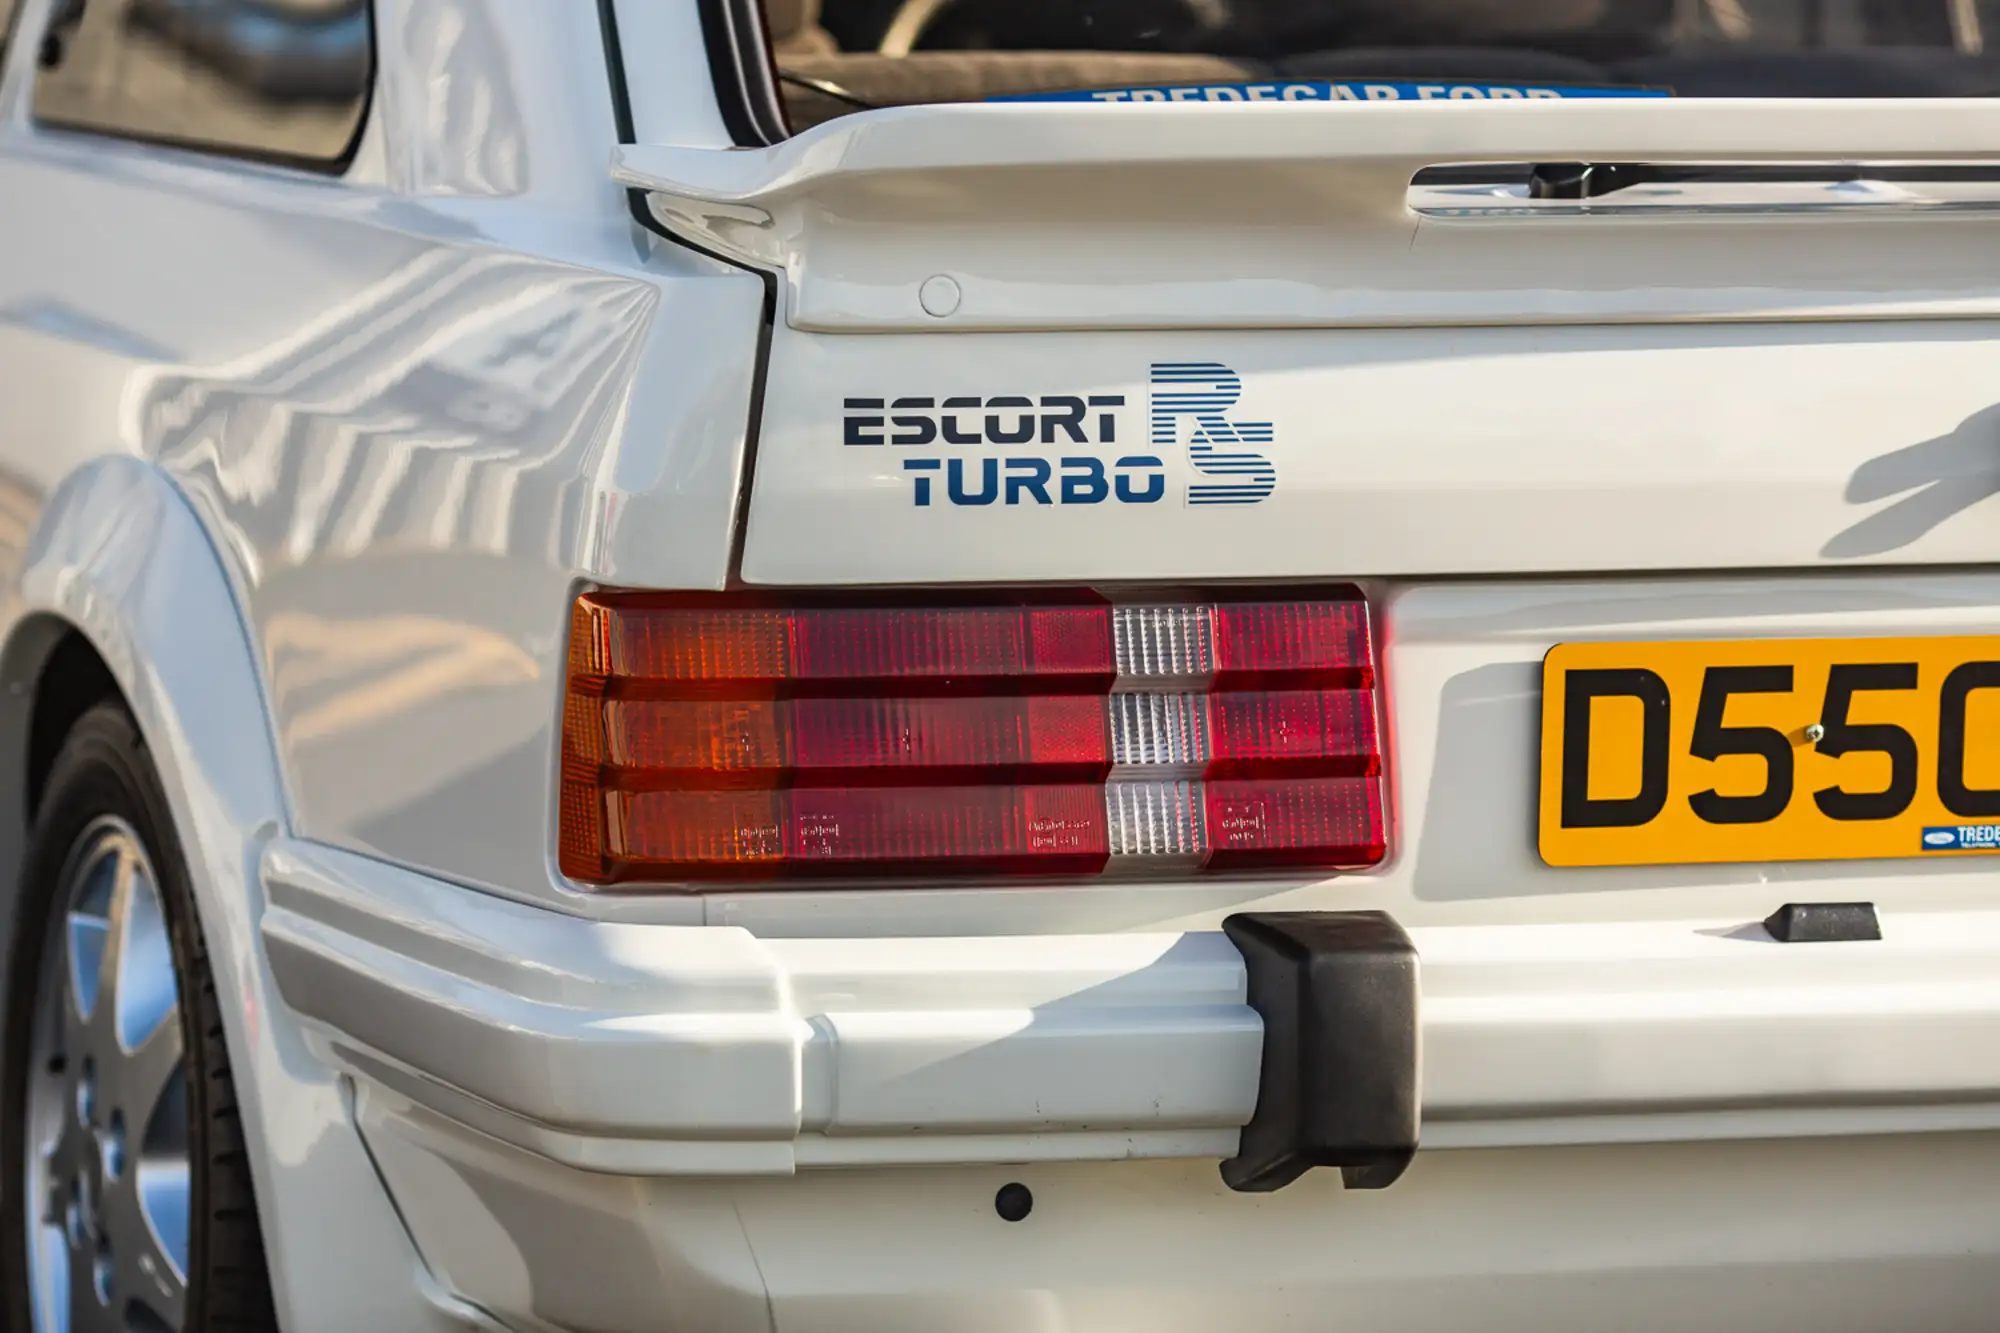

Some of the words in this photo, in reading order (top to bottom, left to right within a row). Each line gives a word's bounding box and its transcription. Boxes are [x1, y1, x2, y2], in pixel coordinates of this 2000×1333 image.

[843, 395, 1125, 445] ESCORT
[1150, 362, 1276, 505] RS
[903, 455, 1165, 506] TURBO
